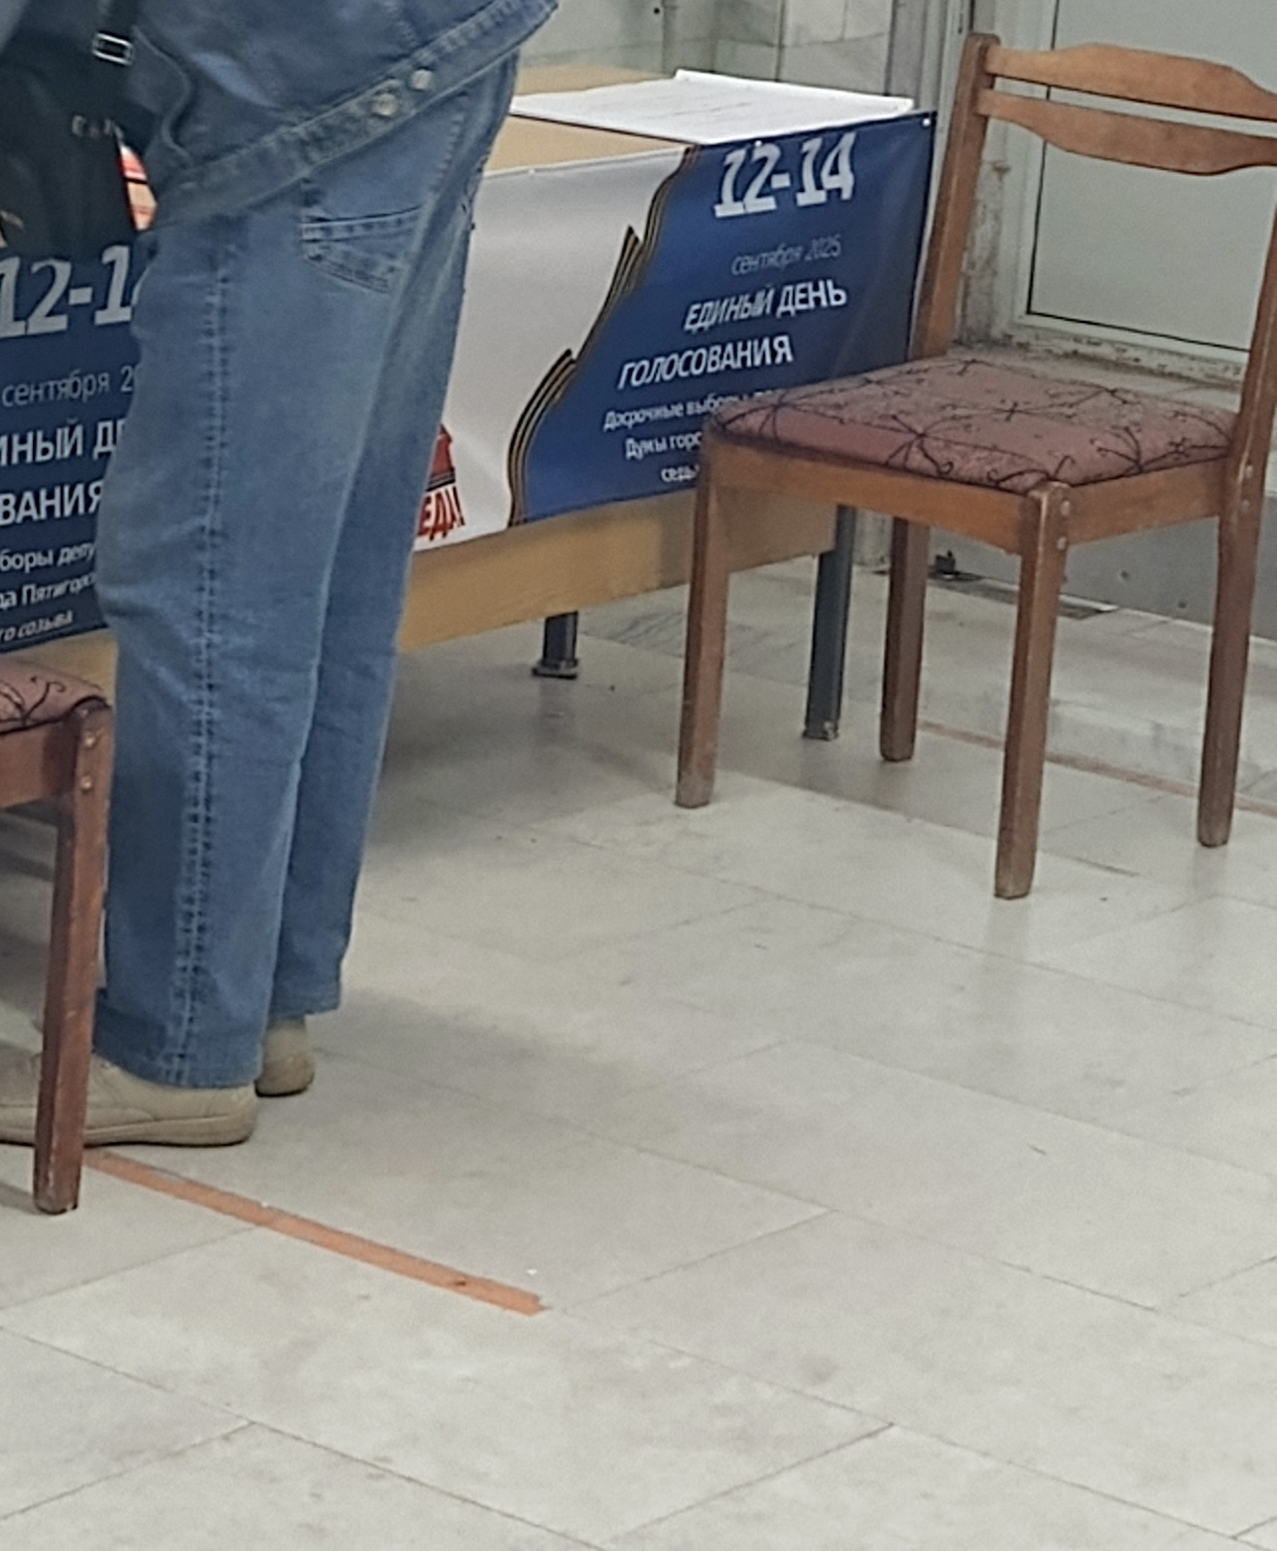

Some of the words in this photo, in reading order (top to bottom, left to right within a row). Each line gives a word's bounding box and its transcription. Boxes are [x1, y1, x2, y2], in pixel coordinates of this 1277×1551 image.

[713, 132, 856, 218] 12-14
[730, 241, 804, 277] сентября
[806, 234, 842, 261] 2025
[684, 285, 773, 332] ЕДИНЫЙ
[775, 279, 848, 318] ДЕНЬ
[617, 335, 794, 390] ГОЛОСОВАНИЯ
[1, 369, 111, 407] сентября
[603, 401, 684, 433] Досрочные
[626, 435, 668, 460] Думы
